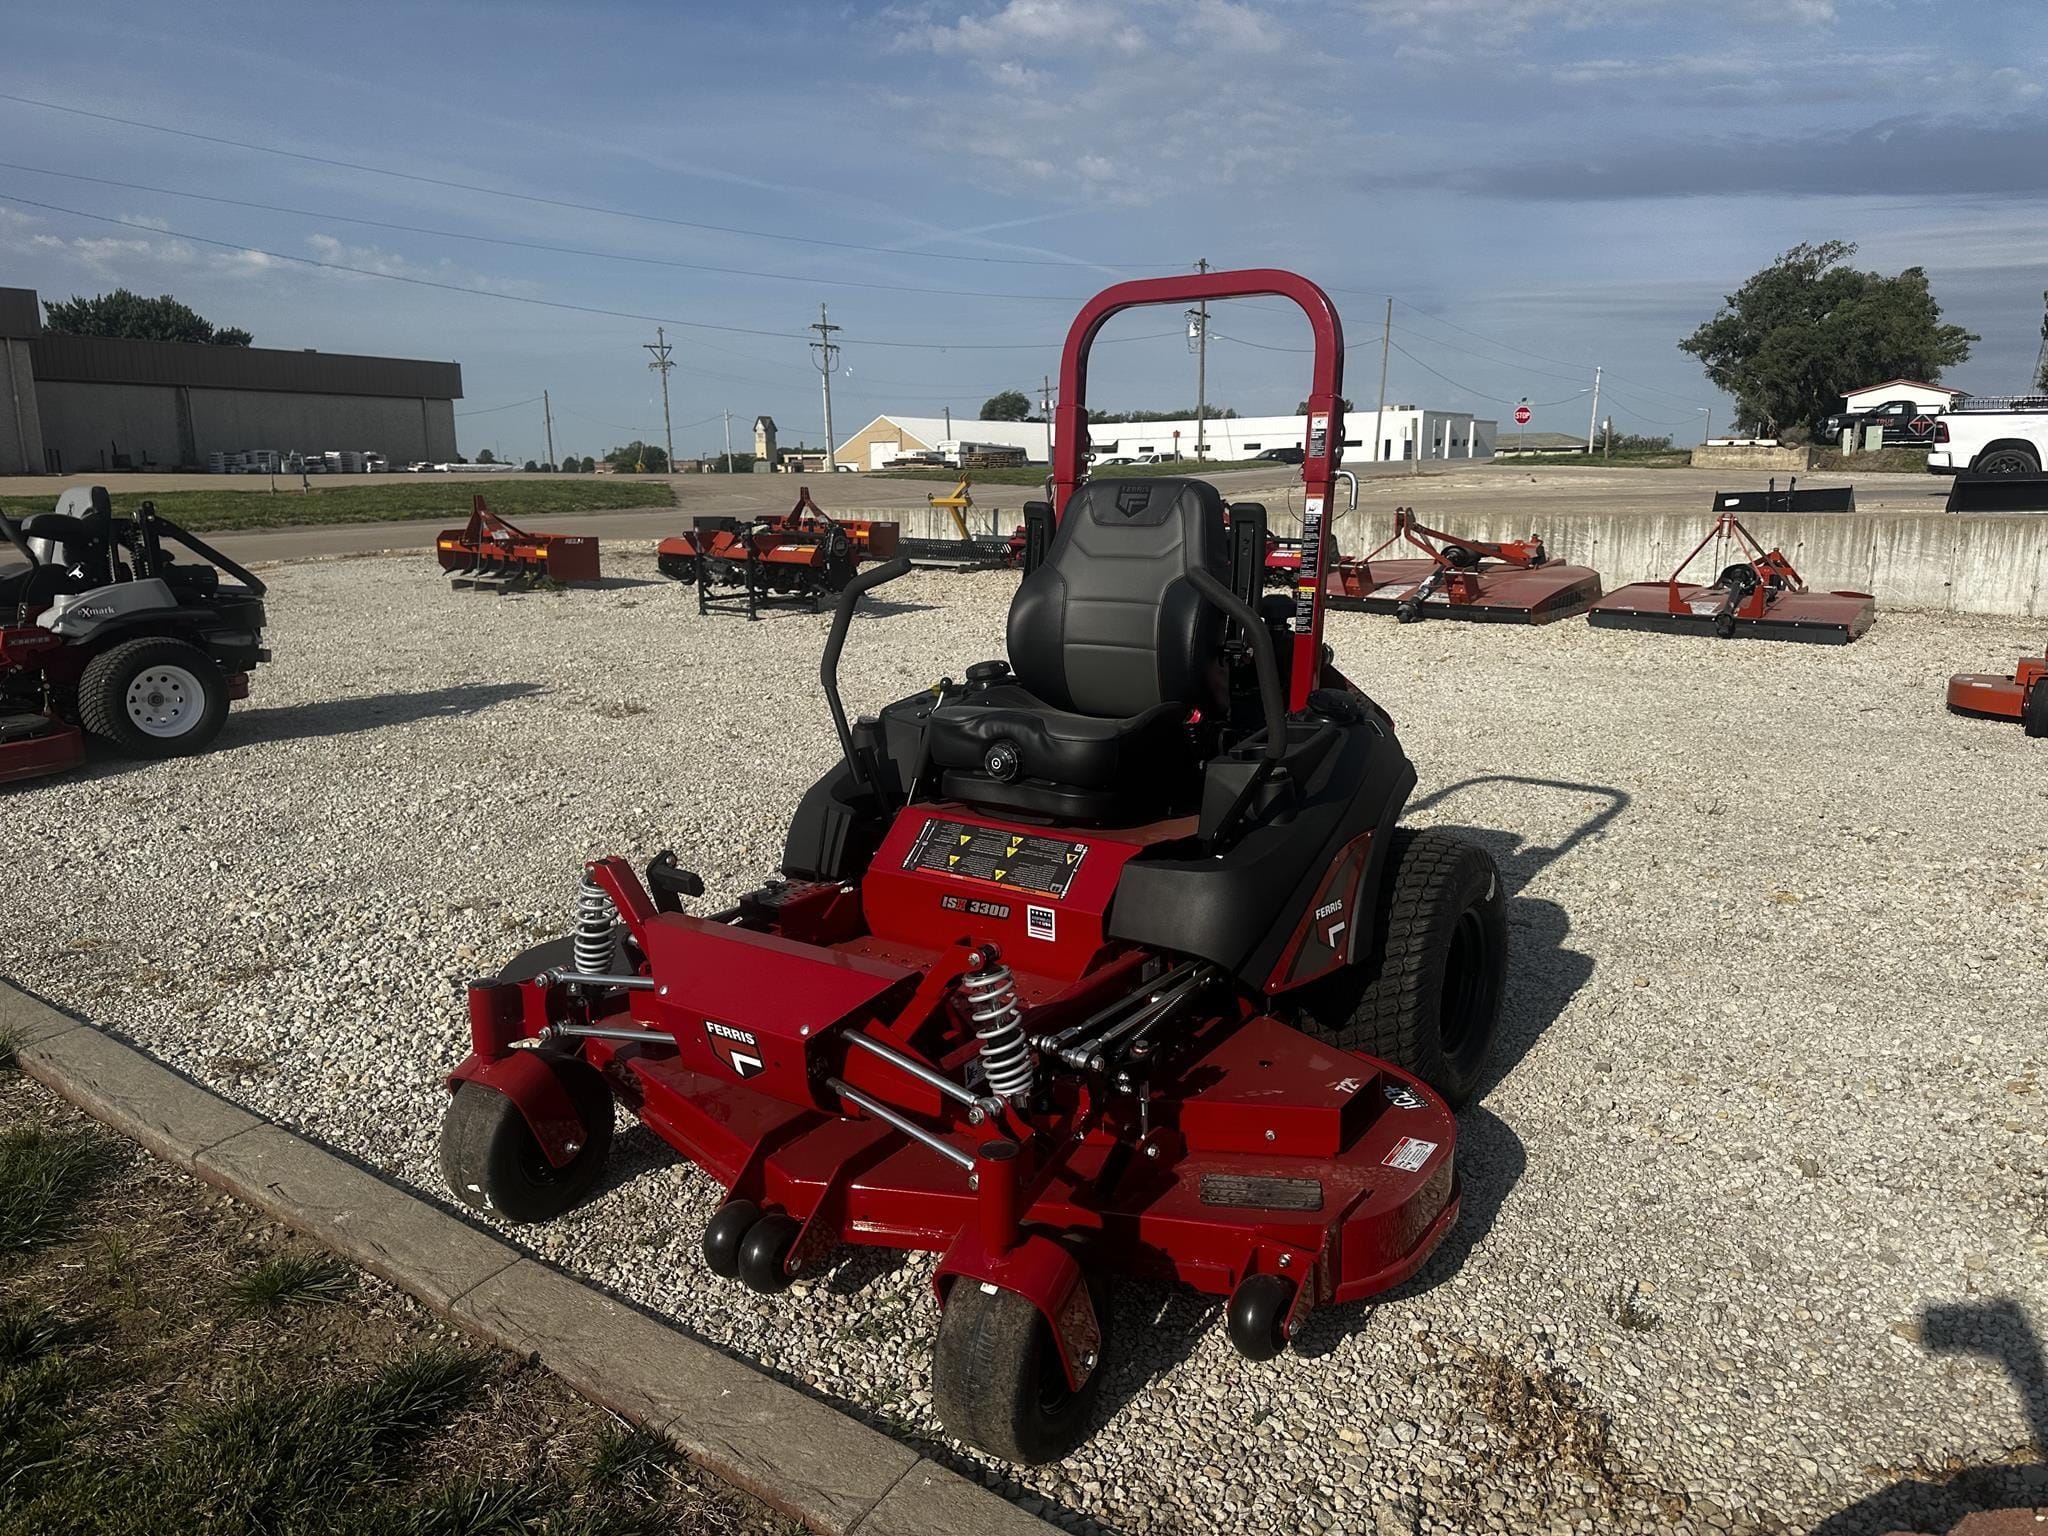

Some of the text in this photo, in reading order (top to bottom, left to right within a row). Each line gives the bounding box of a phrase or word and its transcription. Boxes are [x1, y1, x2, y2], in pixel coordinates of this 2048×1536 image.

[942, 896, 1010, 918] ISX 3300
[1315, 899, 1343, 921] FERRIS
[705, 1021, 755, 1045] FERRIS
